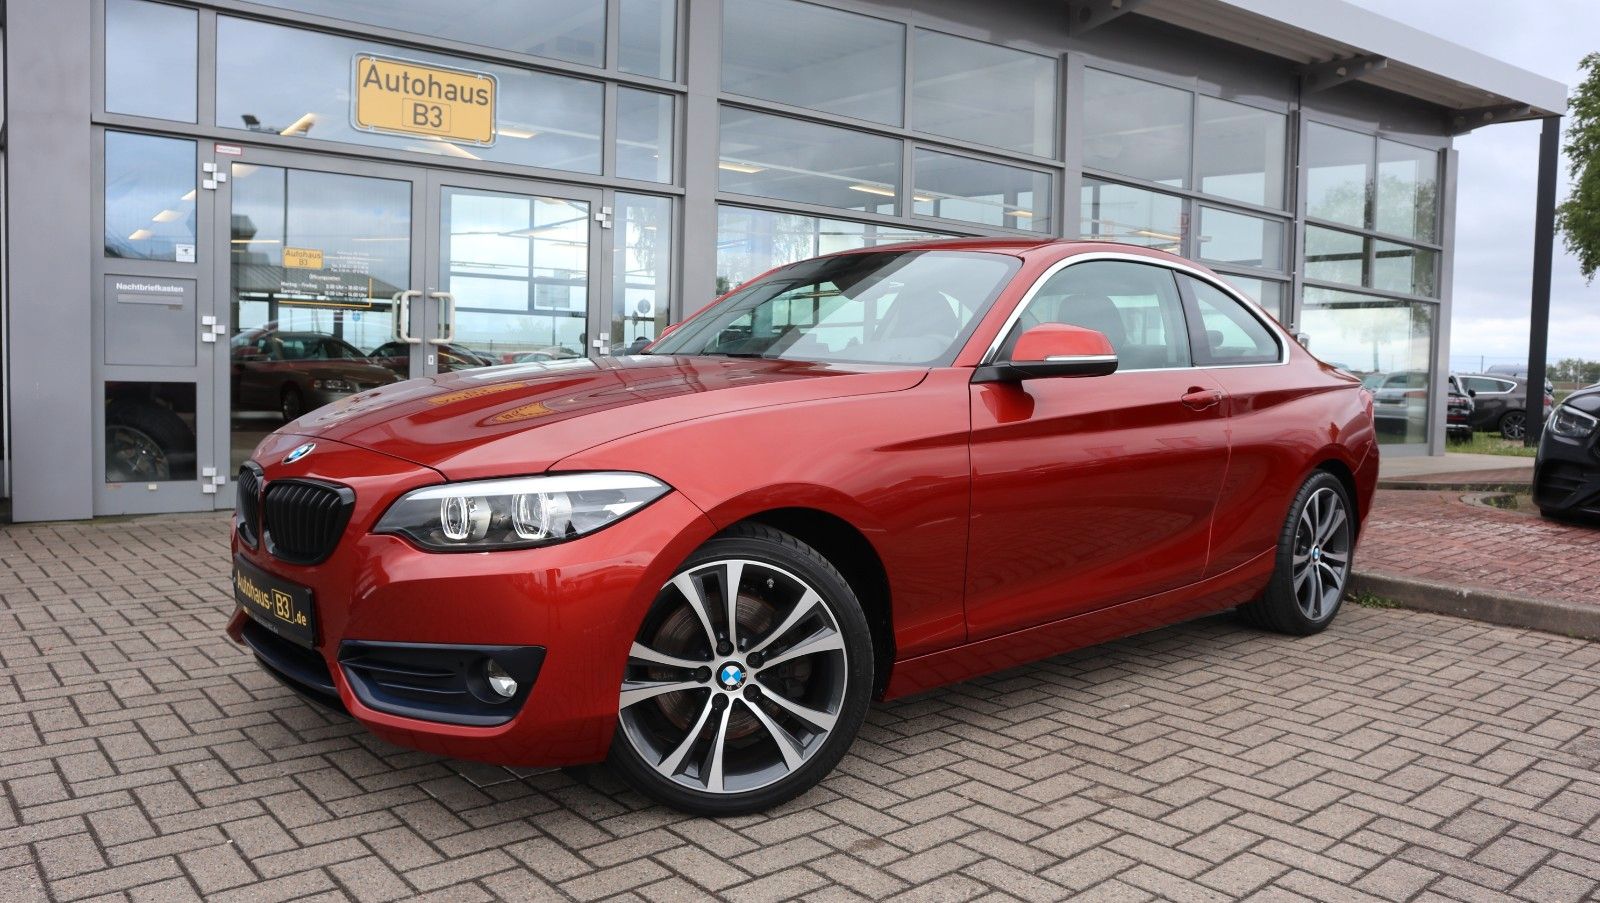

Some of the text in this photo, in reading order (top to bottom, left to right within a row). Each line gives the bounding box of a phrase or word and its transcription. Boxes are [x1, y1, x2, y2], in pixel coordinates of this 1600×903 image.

[362, 63, 489, 107] Autohaus
[413, 102, 443, 128] B3
[285, 249, 321, 259] Autohaus
[298, 258, 308, 266] B3
[116, 282, 184, 293] Nachtbriefkasten
[275, 593, 290, 619] B3
